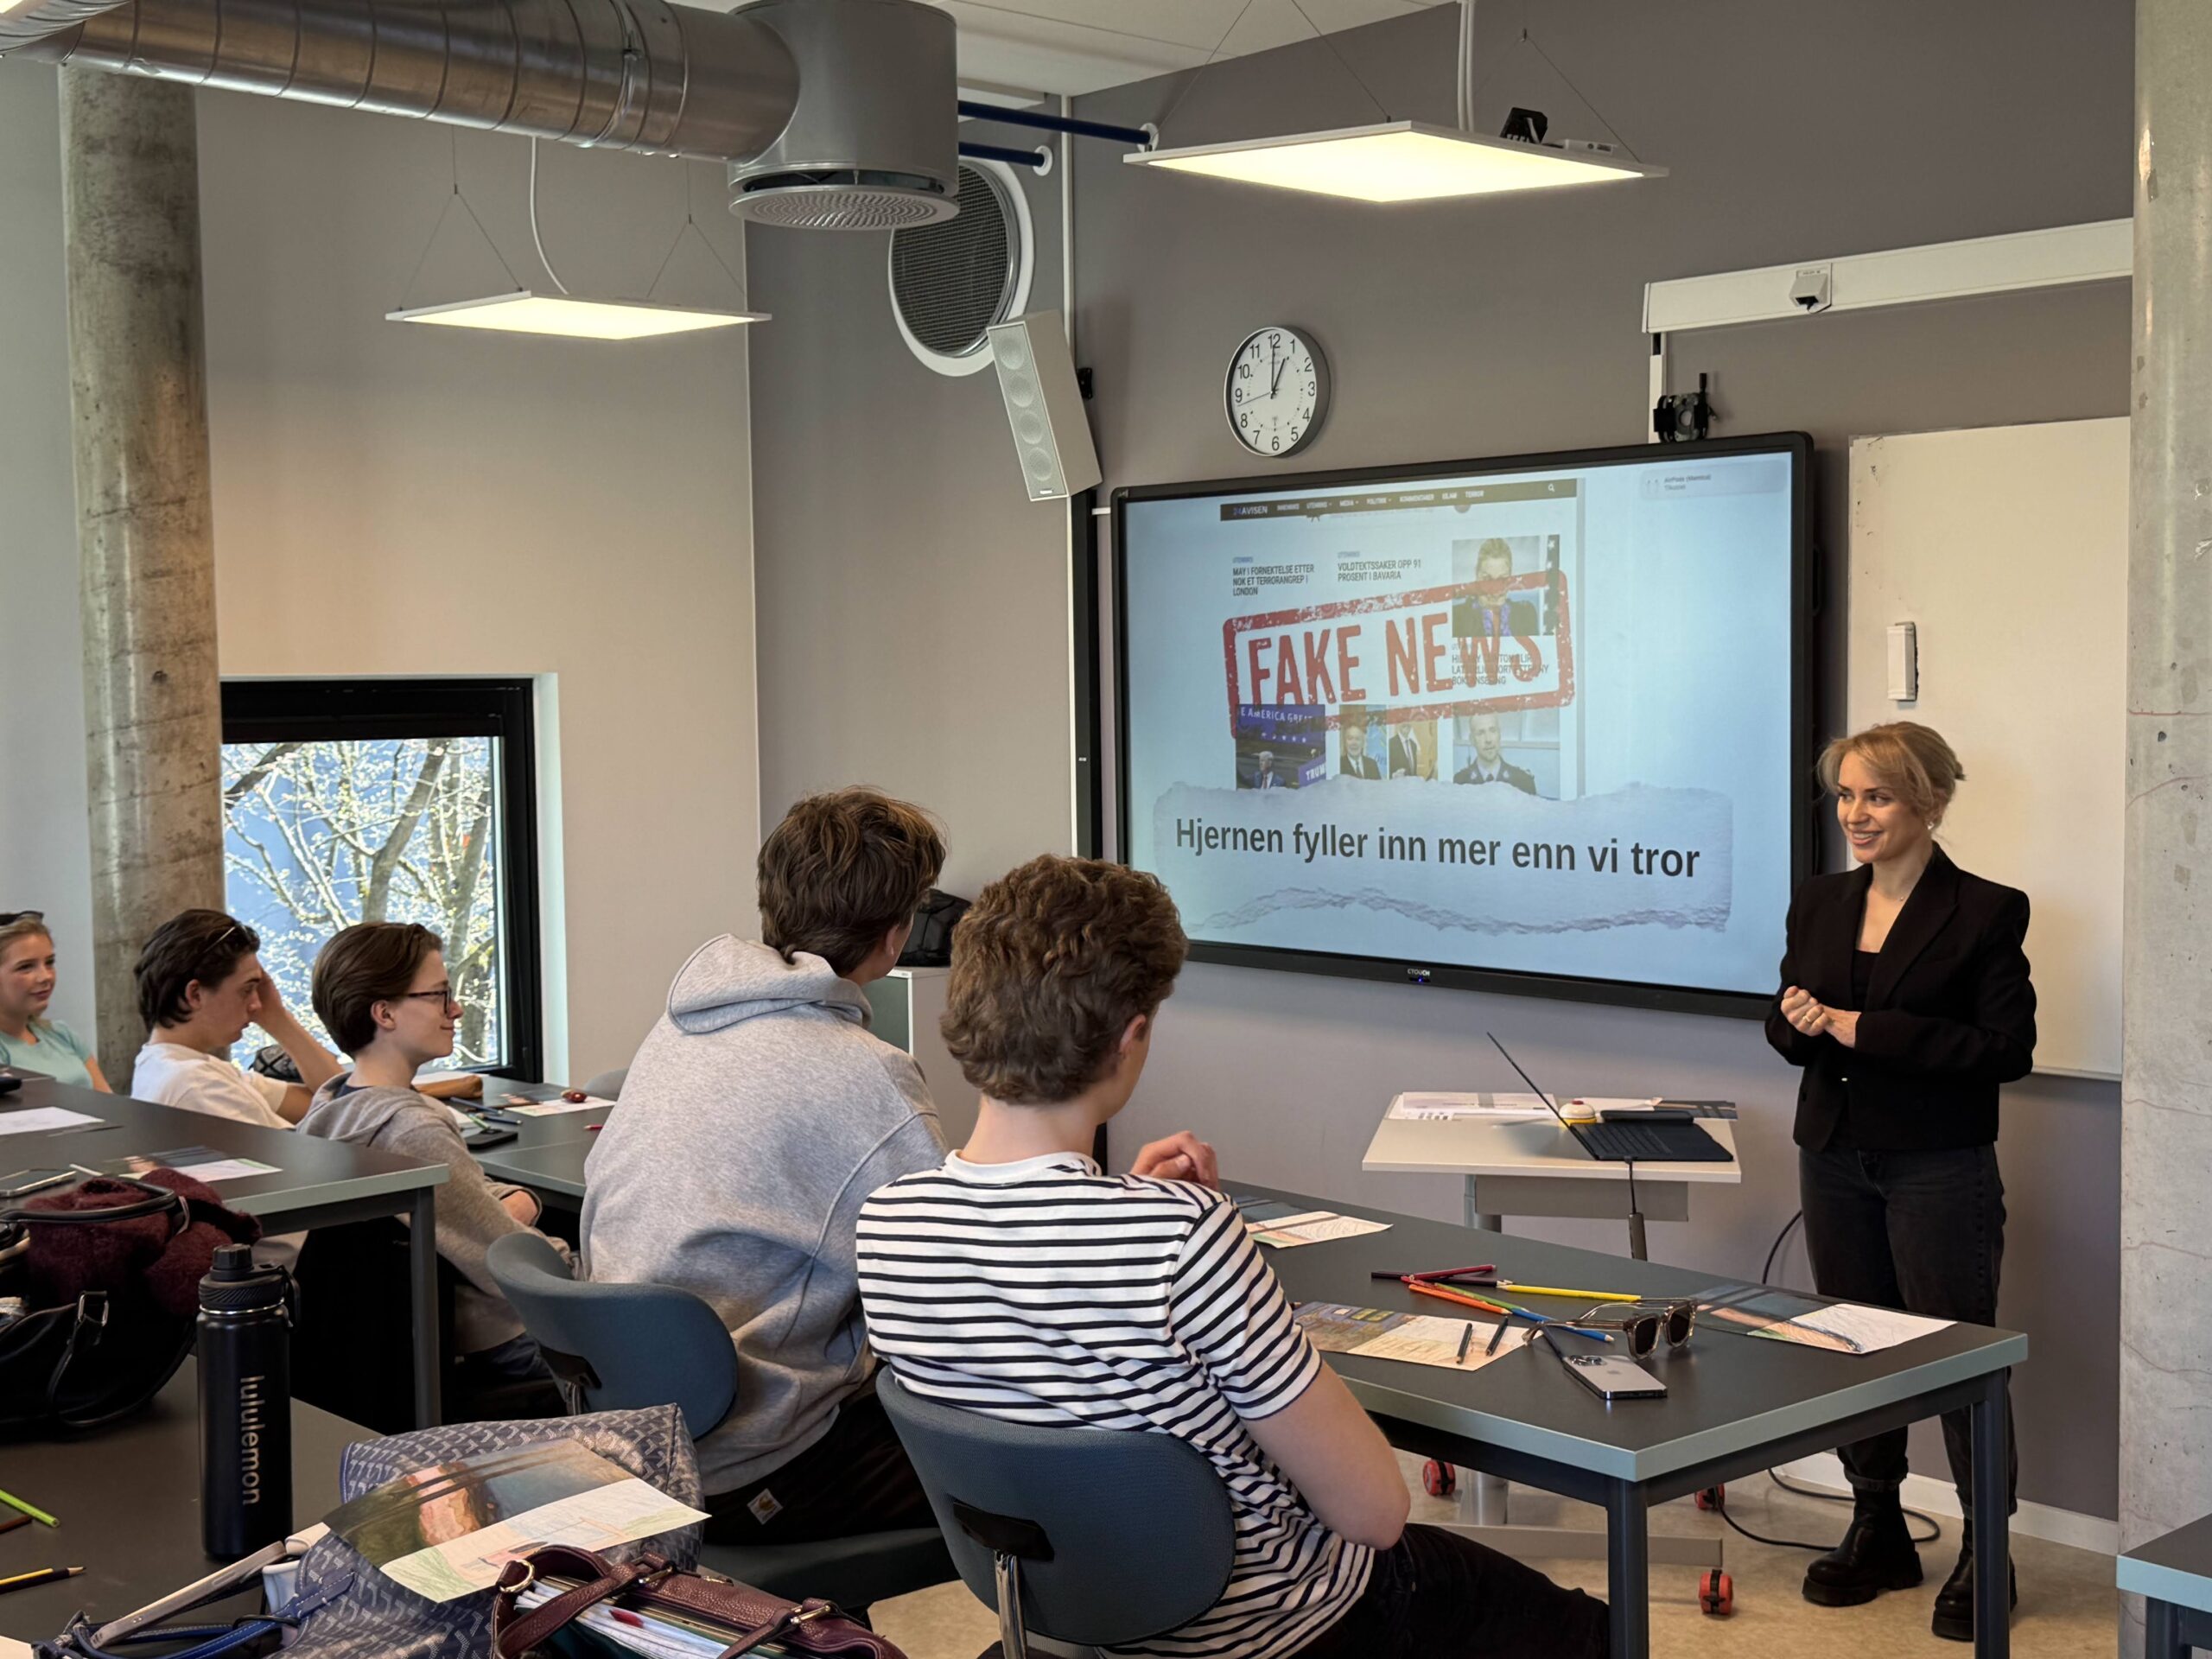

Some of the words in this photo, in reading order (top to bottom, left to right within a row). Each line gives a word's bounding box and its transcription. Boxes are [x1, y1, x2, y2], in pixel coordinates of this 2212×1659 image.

[1268, 334, 1281, 349] 12
[1290, 339, 1295, 354] 1
[1249, 344, 1260, 359] 11
[1237, 364, 1250, 379] 10
[1304, 357, 1313, 372] 2
[1235, 388, 1243, 403] 9
[1308, 381, 1315, 397] 3
[1240, 413, 1248, 428] 8
[1302, 408, 1310, 422] 4
[1253, 430, 1261, 444] 7
[1291, 427, 1299, 442] 5
[1271, 436, 1280, 450] 6
[1233, 567, 1245, 576] MAY
[1251, 565, 1293, 575] FORNEKTELSE
[1294, 564, 1314, 574] ETTER
[1338, 560, 1396, 571] VOLDTEKTSSAKER
[1398, 559, 1411, 569] OPP
[1413, 559, 1421, 569] 91
[1233, 577, 1246, 586] NOK
[1247, 576, 1255, 585] ET
[1256, 575, 1304, 585] TERRORANGREP
[1338, 572, 1367, 582] PROSENT
[1373, 571, 1402, 581] BAVARIA
[1233, 587, 1258, 596] LONDON
[1249, 625, 1366, 710] FAKE
[1248, 709, 1286, 721] AMERICA
[1176, 818, 1283, 856] Hjernen
[1293, 823, 1368, 863] fyller
[1378, 827, 1426, 861] inn
[1438, 838, 1501, 866] mer
[1512, 842, 1575, 871] enn
[1588, 838, 1618, 873] vi
[1630, 842, 1700, 878] tror
[240, 1376, 265, 1505] lululemon
